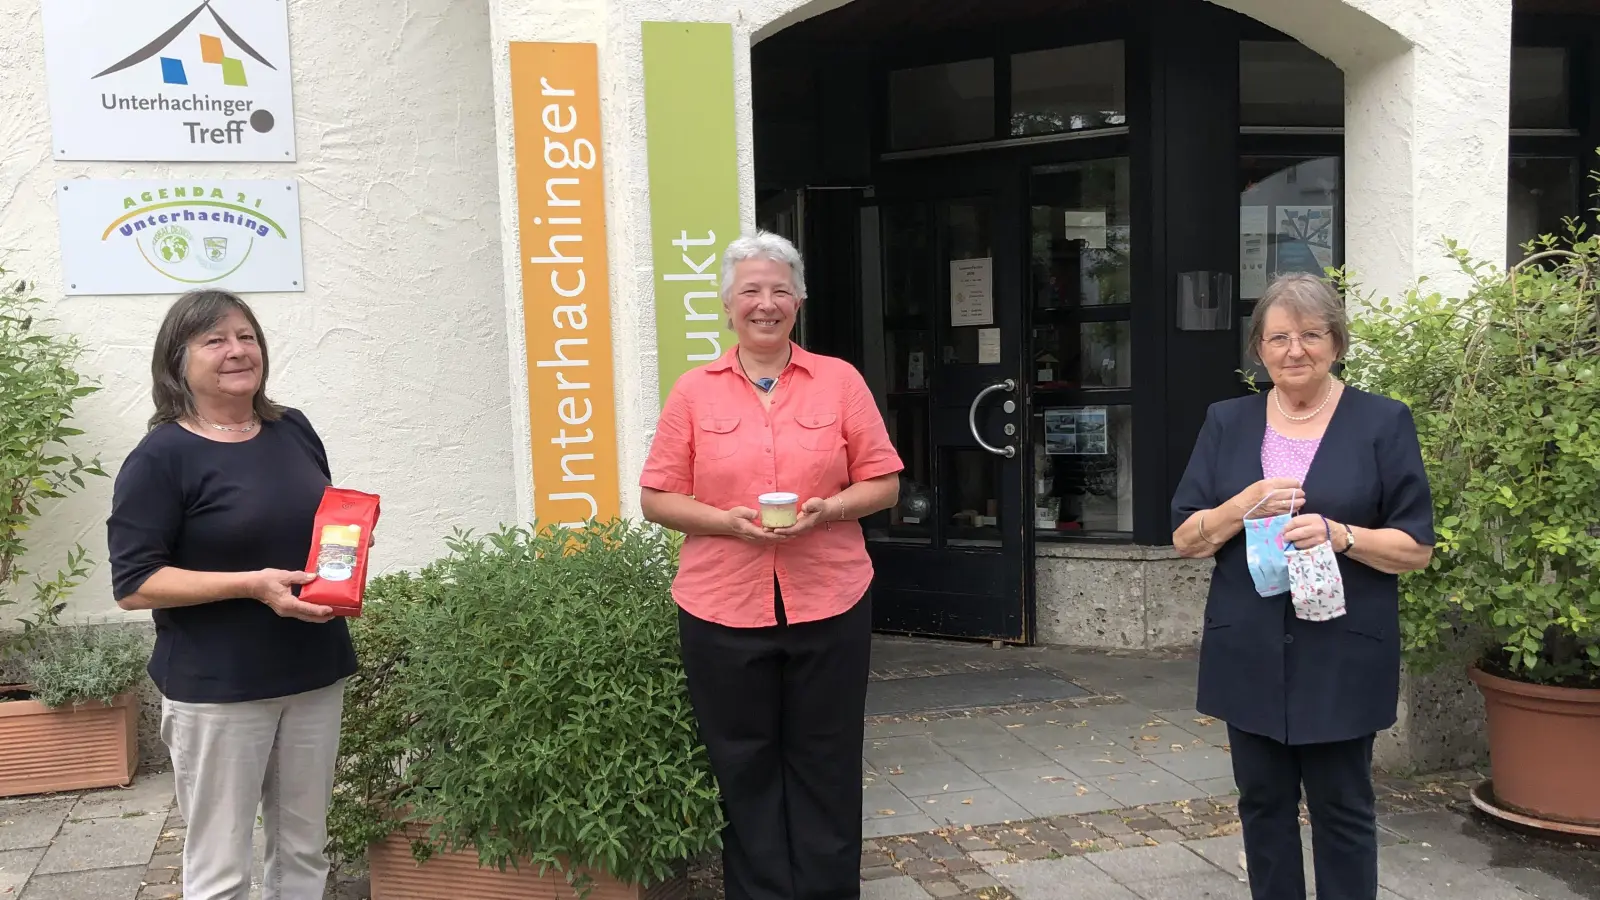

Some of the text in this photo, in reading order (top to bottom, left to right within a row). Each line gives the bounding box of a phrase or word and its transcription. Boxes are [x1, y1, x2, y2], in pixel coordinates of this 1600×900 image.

[101, 93, 253, 116] Unterhachinger
[183, 120, 247, 144] Treff
[123, 186, 224, 209] AGENDA
[119, 209, 270, 237] Unterhaching
[531, 76, 598, 530] Unterhachinger
[663, 229, 721, 361] unkt
